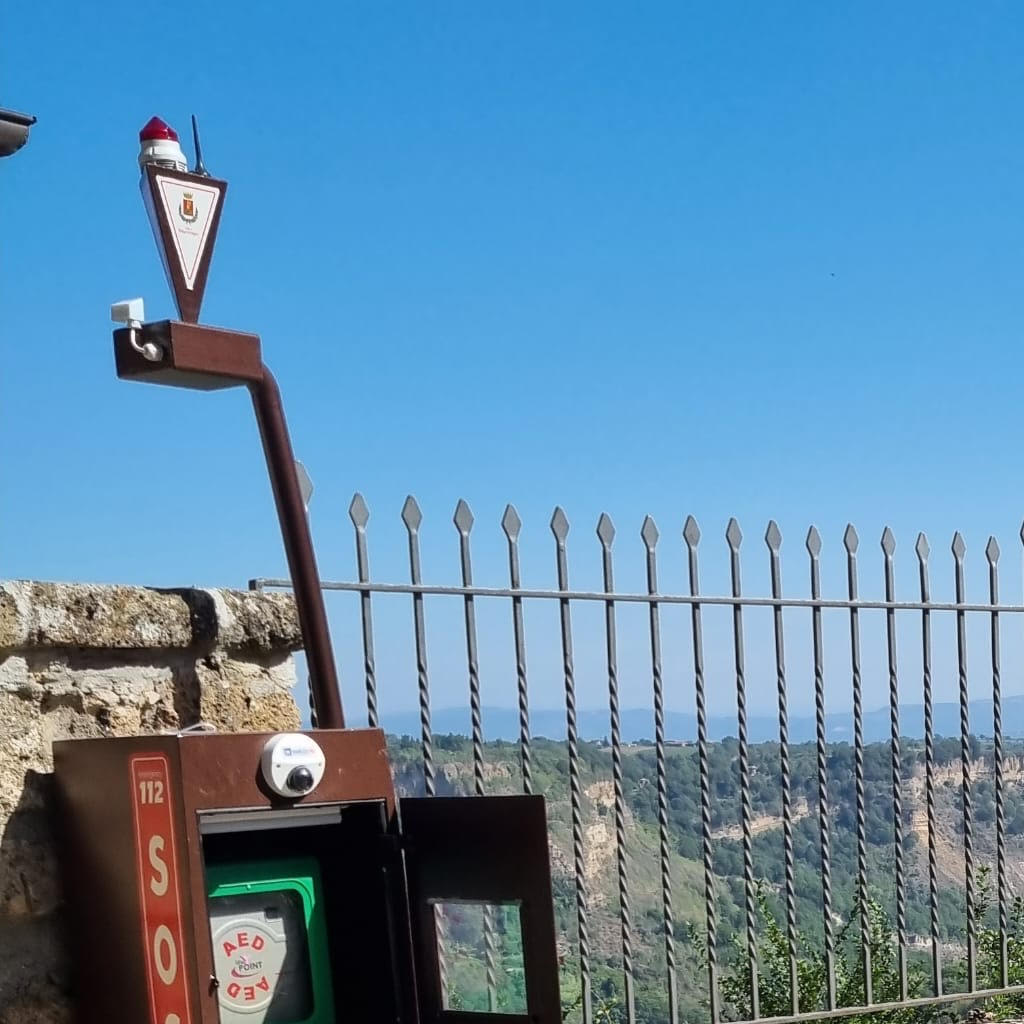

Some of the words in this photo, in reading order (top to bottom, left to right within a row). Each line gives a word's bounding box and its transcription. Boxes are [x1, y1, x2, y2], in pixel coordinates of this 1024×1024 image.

[139, 780, 164, 804] 112
[222, 932, 265, 957] AED
[238, 961, 263, 973] POINT
[226, 976, 270, 1001] AED
